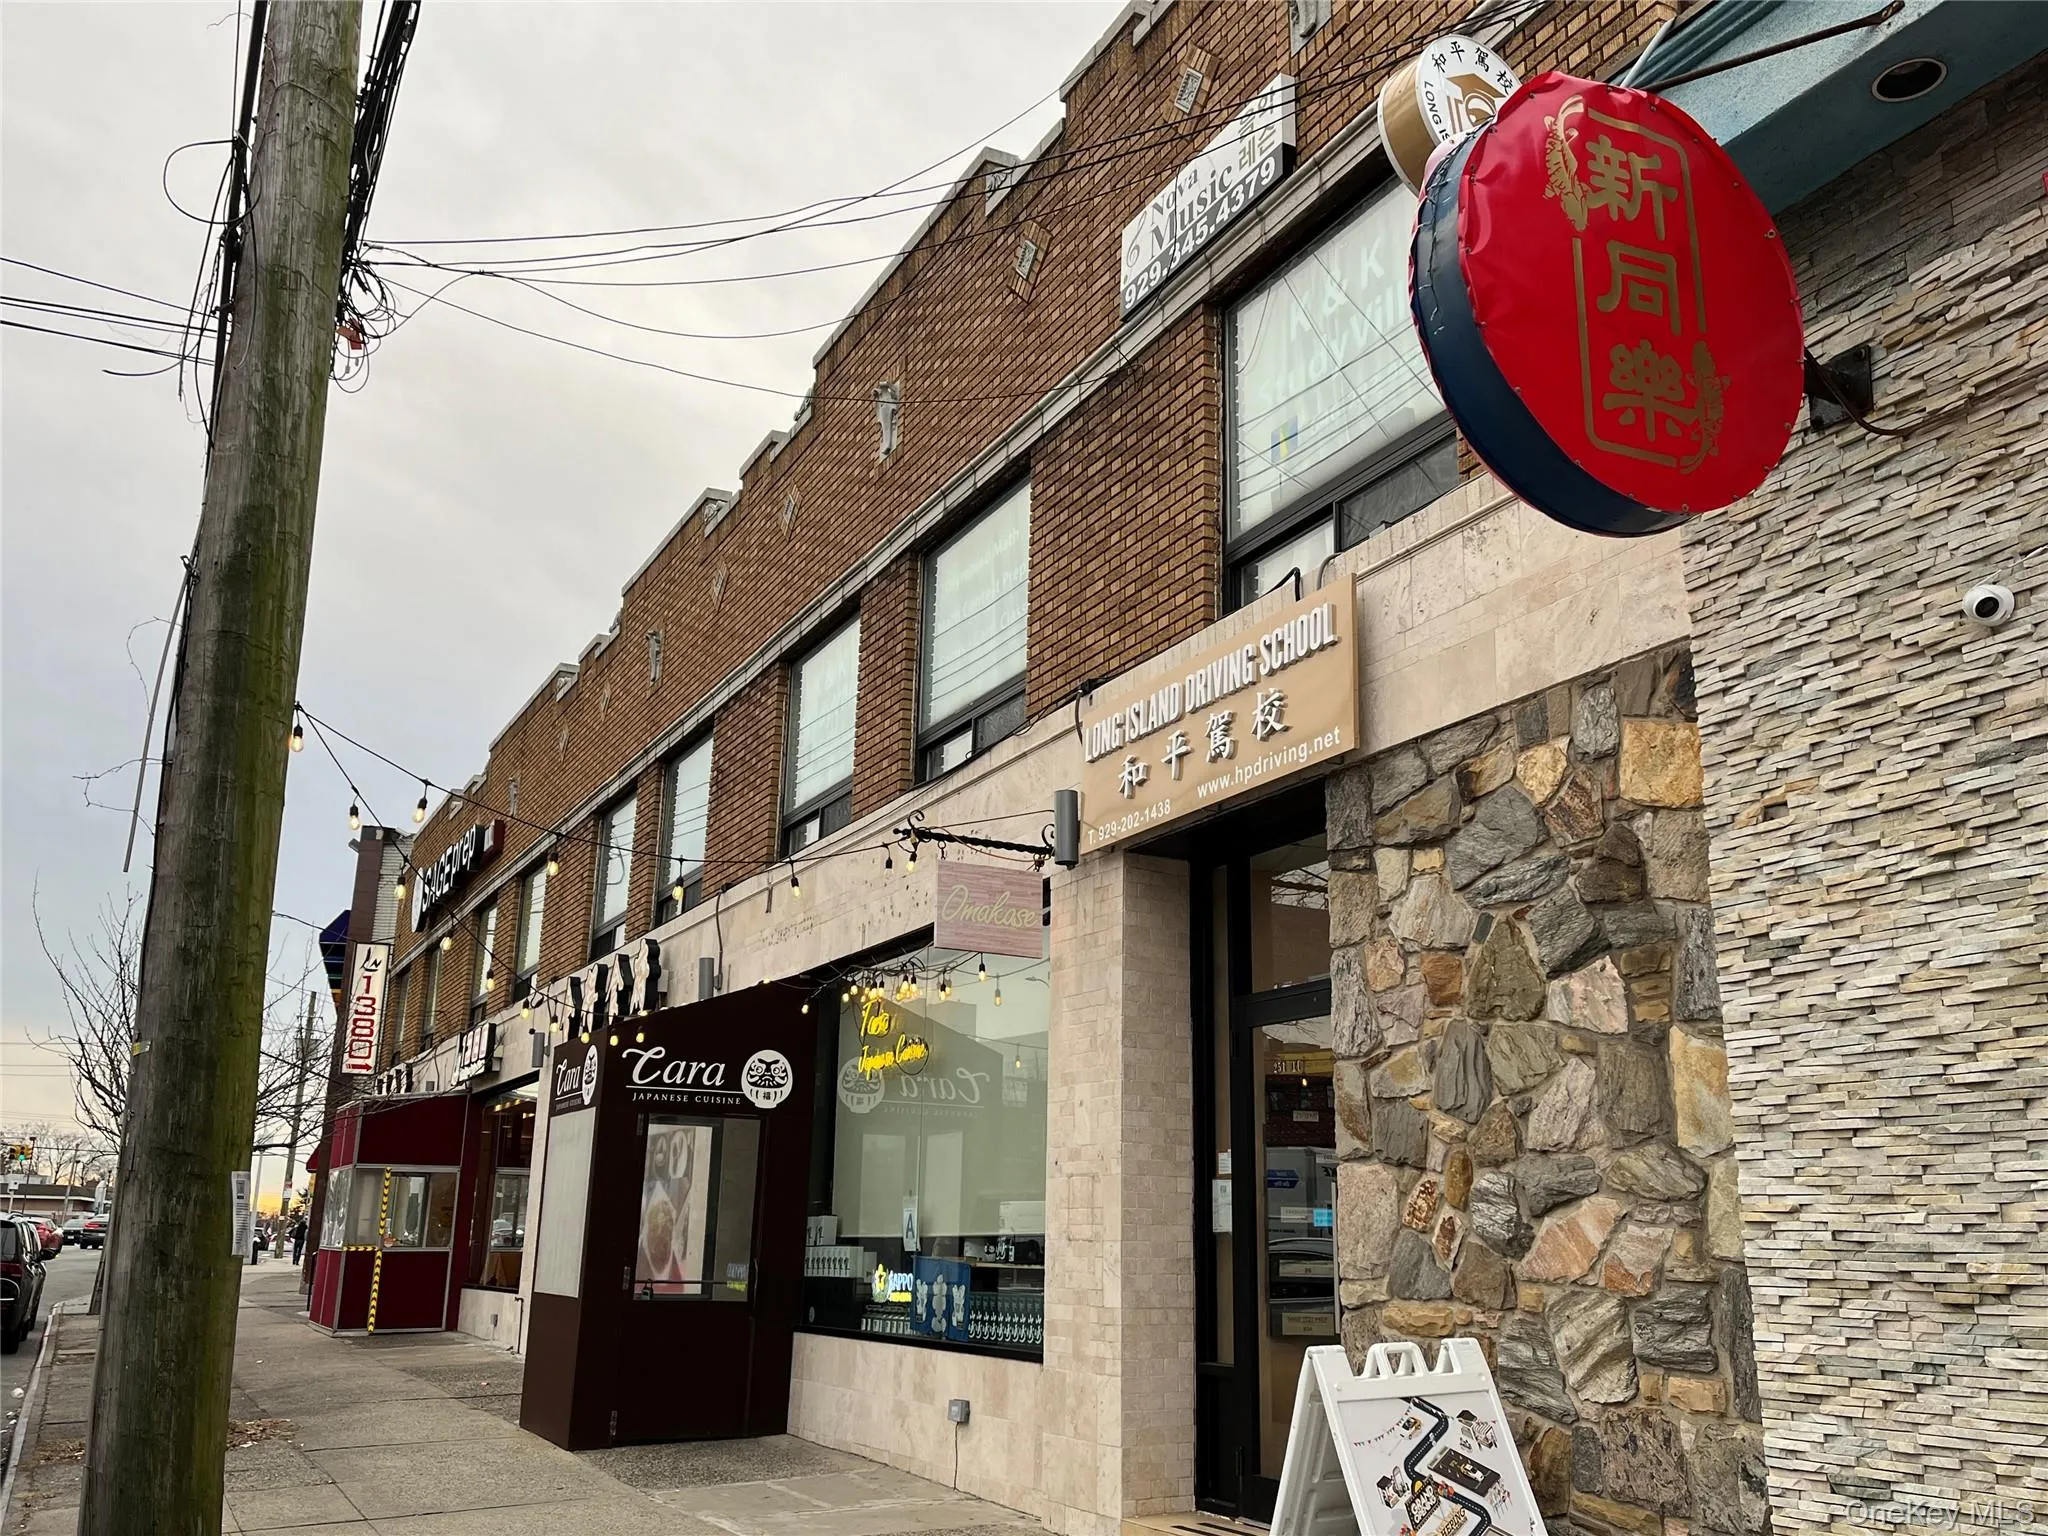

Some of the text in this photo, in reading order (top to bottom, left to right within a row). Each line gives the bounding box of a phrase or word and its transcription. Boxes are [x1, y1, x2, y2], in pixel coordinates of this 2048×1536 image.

[1432, 41, 1514, 95] 和平駕校
[1424, 81, 1442, 125] LONG
[1239, 124, 1276, 170] 레슨
[1150, 165, 1233, 260] Music
[1152, 168, 1200, 217] Nova
[1124, 156, 1276, 310] 929.345.4379
[1361, 237, 1385, 291] K
[1585, 136, 1699, 442] 新同樂
[1085, 603, 1338, 763] LONG ISLAND DRIVING SCHOOL
[1118, 688, 1288, 798] 和平駕校
[1197, 727, 1341, 798] www.hpdriving.net
[1098, 799, 1171, 842] 929-202-1438
[422, 824, 477, 912] SAGEprep
[941, 884, 1038, 928] Omakase
[348, 975, 377, 1060] 1380
[632, 1091, 742, 1105] JAPANESE CUISINE
[905, 1213, 915, 1239] A
[1411, 1485, 1433, 1514] GRAND
[1441, 1507, 1466, 1536] HERING
